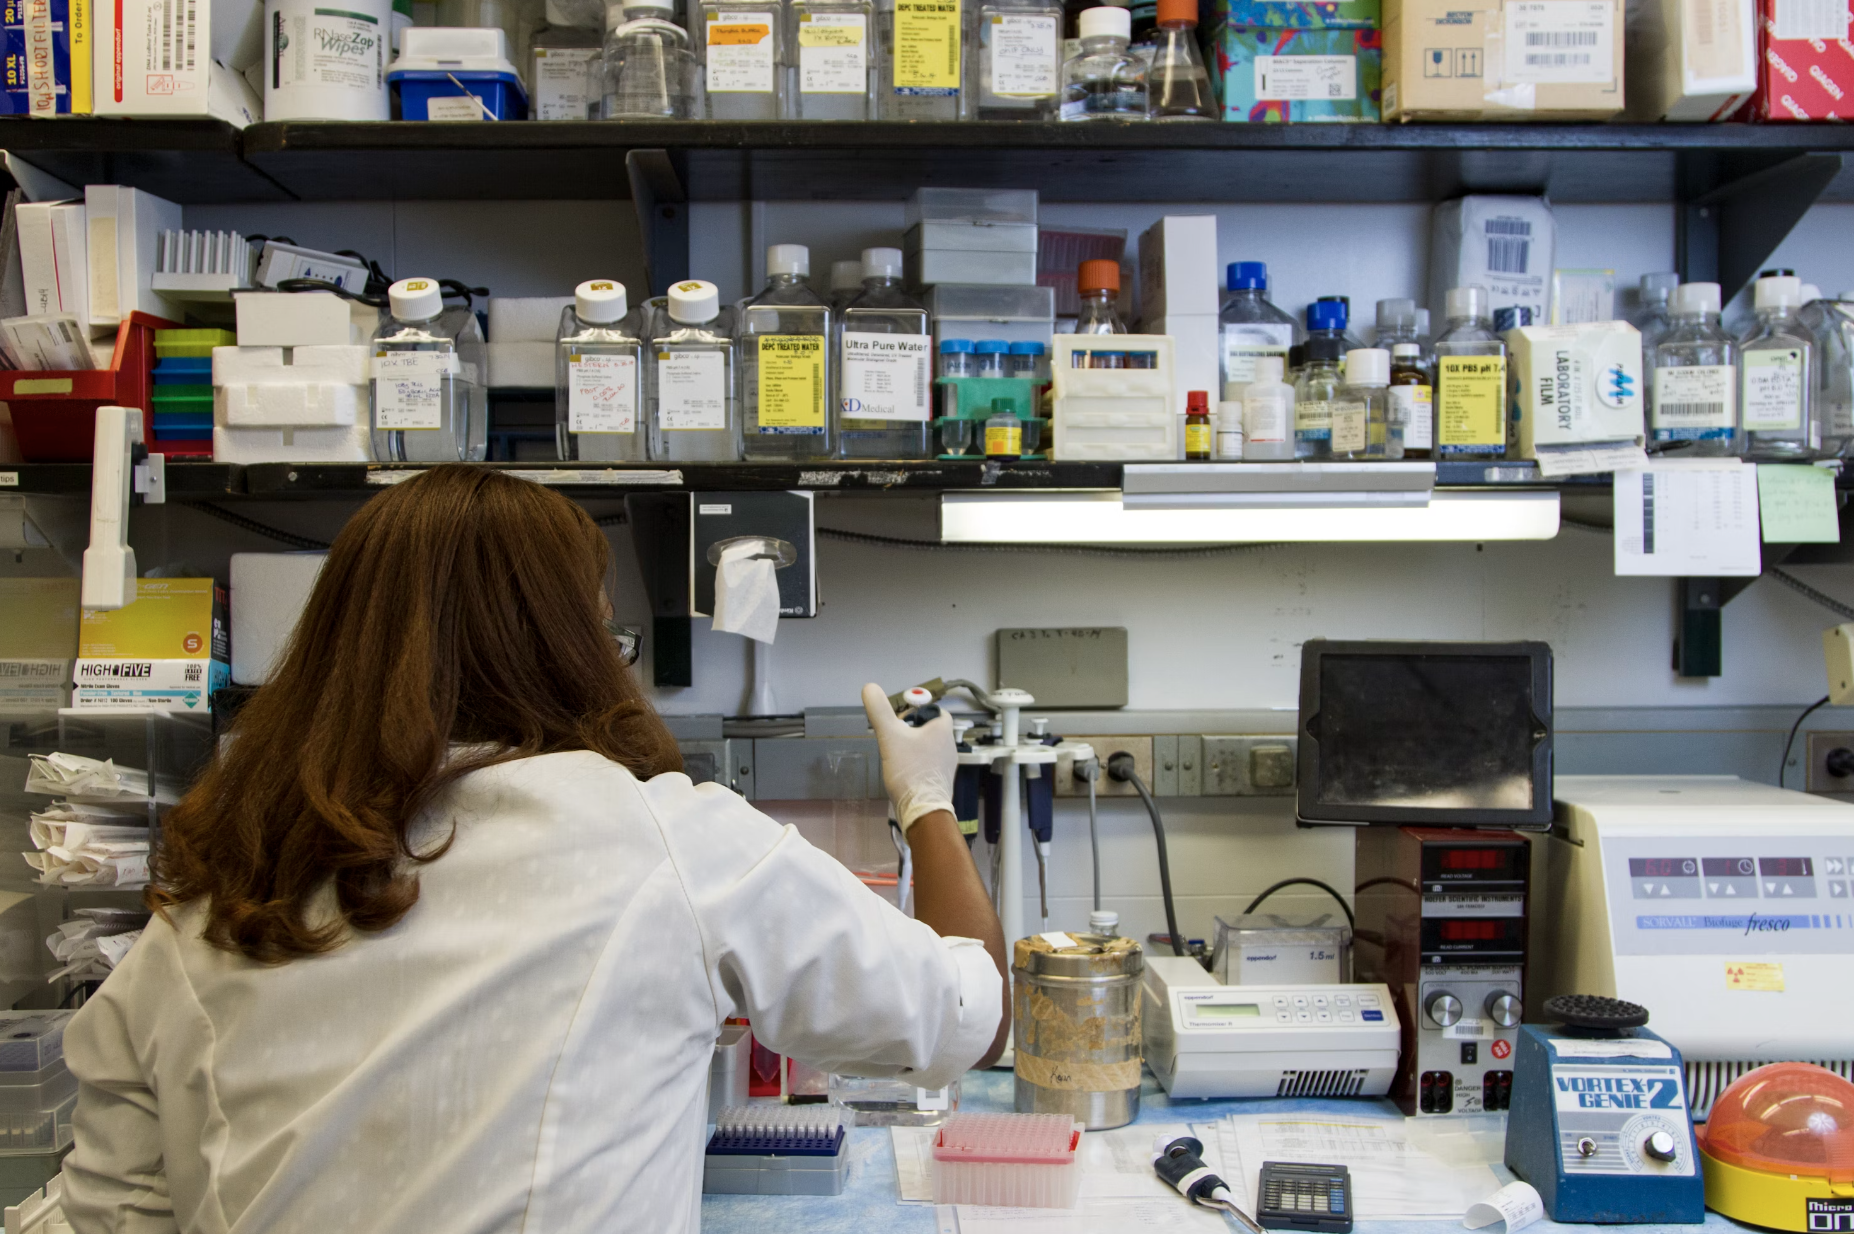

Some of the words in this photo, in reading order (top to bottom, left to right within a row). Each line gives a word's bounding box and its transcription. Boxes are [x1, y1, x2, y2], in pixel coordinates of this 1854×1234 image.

[75, 33, 83, 44] To
[320, 38, 366, 56] Wipes
[6, 54, 16, 69] XL
[1809, 65, 1844, 100] QIAGEN
[846, 340, 869, 350] Ultra
[872, 341, 896, 350] Pure
[898, 341, 928, 352] Water
[1446, 364, 1460, 372] 10X
[1462, 364, 1478, 372] PBS
[1480, 364, 1491, 374] pH
[1540, 377, 1554, 406] FILM
[1556, 350, 1572, 430] LABORATORY
[862, 404, 895, 414] Medical
[187, 638, 198, 648] S
[80, 664, 112, 676] HIGH
[121, 663, 152, 676] FIVE
[1704, 916, 1744, 930] Biofuge
[1744, 912, 1790, 936] fresco
[1310, 952, 1324, 960] 1.5
[1578, 1094, 1648, 1108] GENIE
[1646, 1078, 1682, 1109] 2
